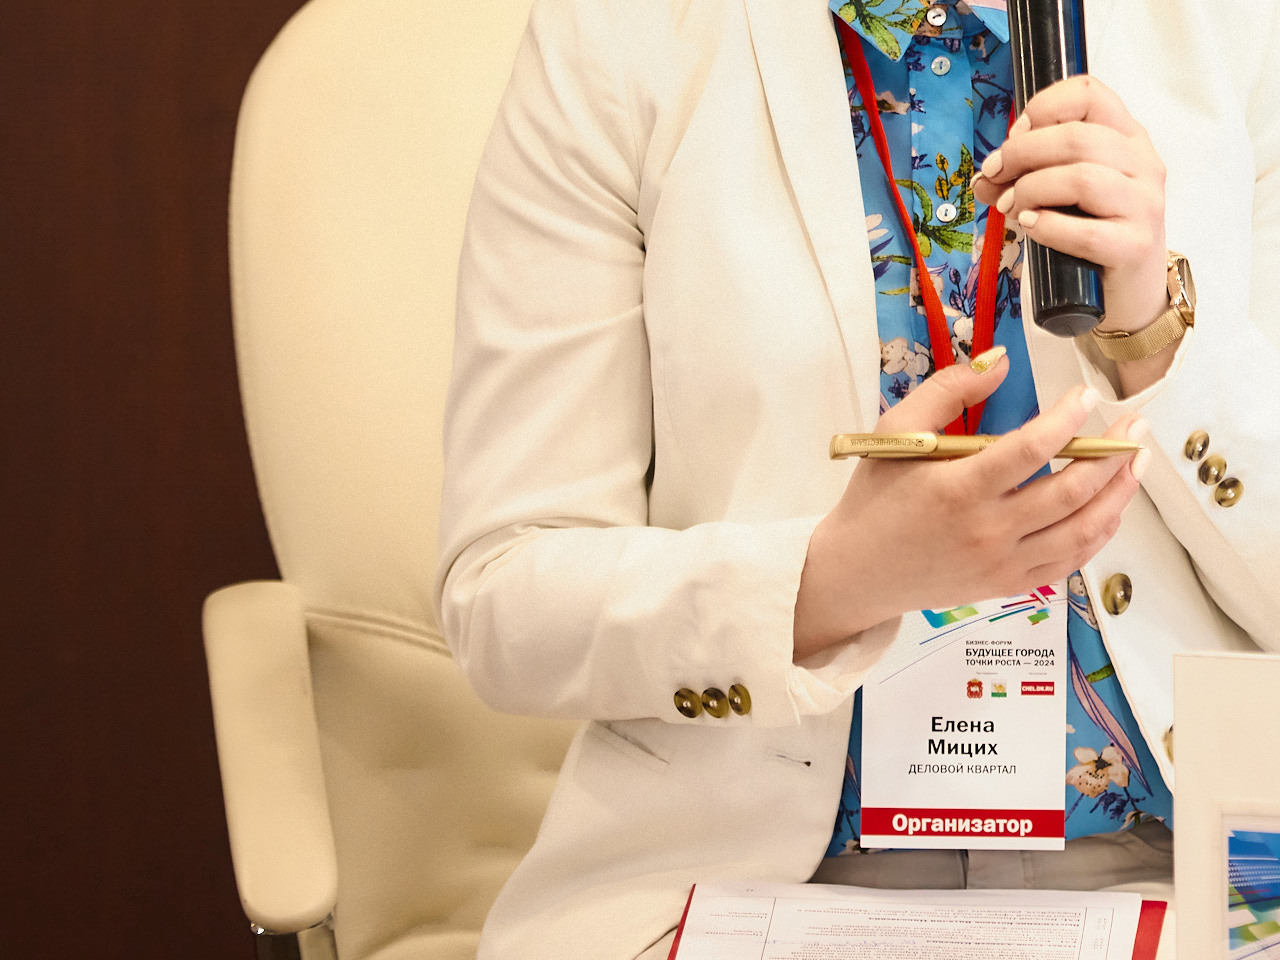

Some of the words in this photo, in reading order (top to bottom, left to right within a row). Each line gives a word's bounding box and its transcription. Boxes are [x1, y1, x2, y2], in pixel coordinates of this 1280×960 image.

[965, 648, 1014, 659] БУДУЩЕЕ
[1015, 648, 1055, 659] ГОРОДА
[931, 716, 995, 733] Елена
[928, 739, 998, 758] Мицих
[908, 762, 964, 775] ДЕЛОВОЙ
[967, 765, 1017, 775] КВАРТАЛ
[892, 813, 1033, 836] Организатор
